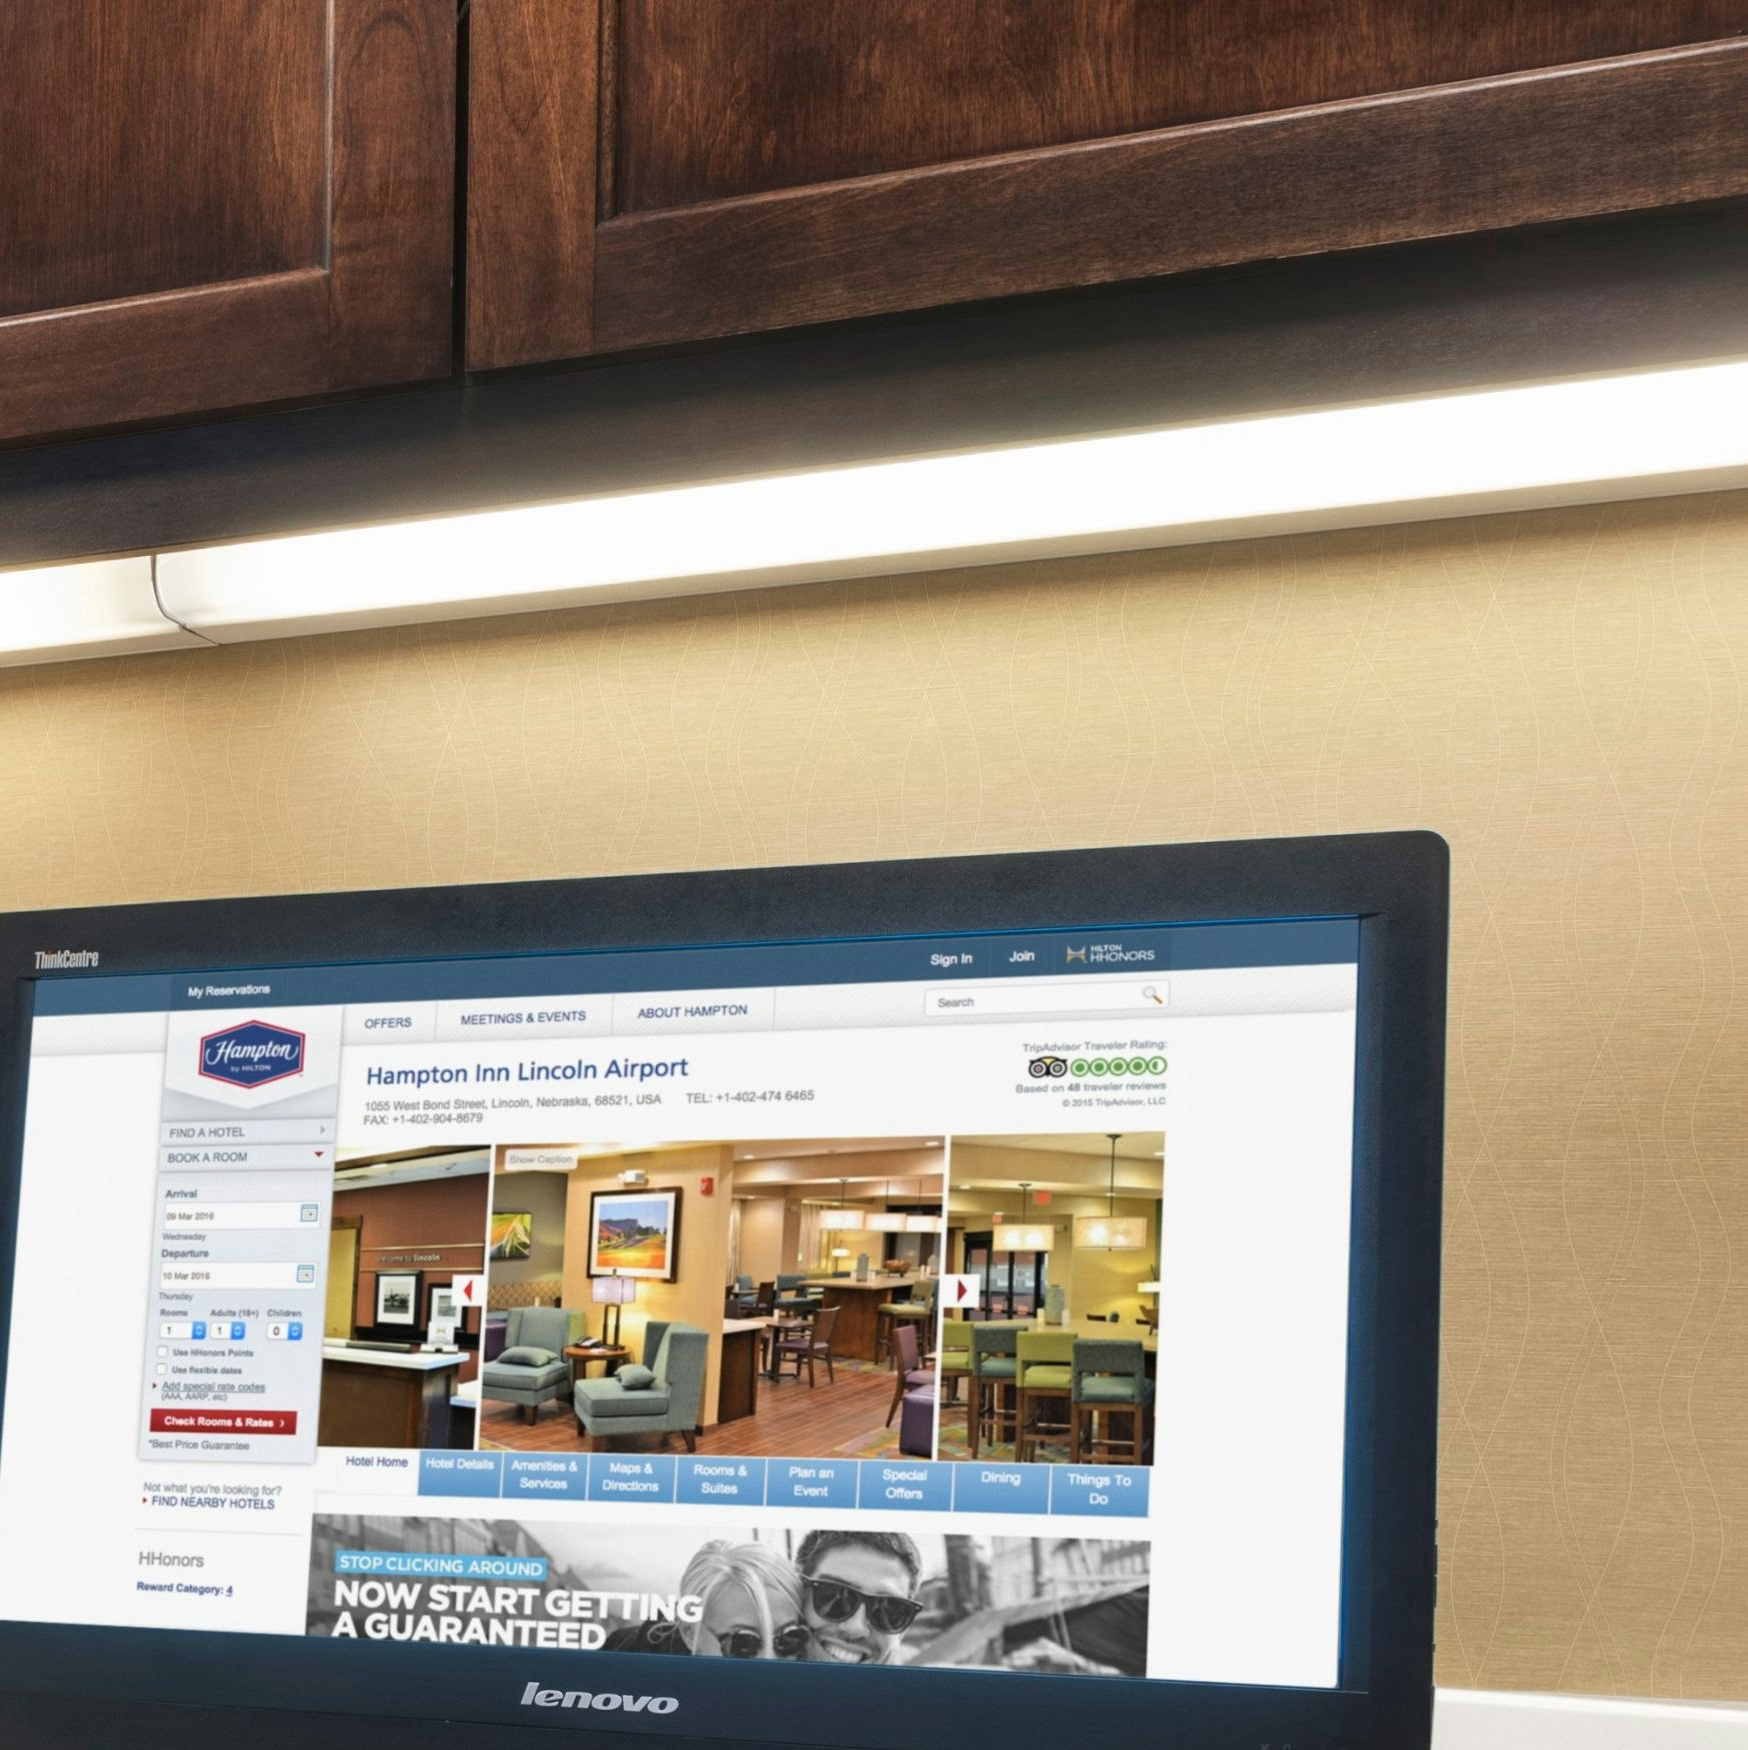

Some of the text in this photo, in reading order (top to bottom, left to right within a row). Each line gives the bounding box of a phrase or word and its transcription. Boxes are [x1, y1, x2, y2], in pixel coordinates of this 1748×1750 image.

[1090, 944, 1123, 952] HILTON
[34, 949, 99, 970] ThinkCentre
[930, 953, 973, 968] Sign In
[1009, 951, 1035, 962] Join
[1090, 951, 1155, 963] HHONORS
[188, 983, 270, 999] My Reservations
[937, 998, 974, 1008] Search
[460, 1011, 586, 1025] MEETINGS & EVENTS
[637, 1005, 748, 1019] ABOUT HAMPTON
[364, 1017, 412, 1029] OFFERS
[205, 1040, 299, 1066] Hampton
[1023, 1039, 1167, 1054] TripAdvisor Traveler Rating:
[367, 1058, 689, 1088] Hampton Inn Lincoln Airport
[1015, 1084, 1049, 1094] Based
[1067, 1083, 1081, 1092] 48
[1083, 1082, 1123, 1092] traveler
[1125, 1081, 1167, 1090] reviews
[364, 1100, 390, 1111] 1055
[393, 1099, 418, 1110] West
[420, 1098, 451, 1110] Bond
[453, 1097, 488, 1111] Street,
[492, 1097, 531, 1110] Lincoln,
[536, 1095, 591, 1109] Nebraska,
[636, 1094, 662, 1105] USA
[686, 1092, 712, 1103] TEL:
[784, 1090, 814, 1101] 6465
[364, 1114, 389, 1125] FAX:
[169, 1127, 245, 1138] FIND A HOTEL
[168, 1152, 248, 1163] BOOK A ROOM
[509, 1155, 573, 1165] Show Caption
[165, 1189, 197, 1198] Arrival
[195, 1212, 214, 1220] 2016
[163, 1233, 206, 1242] Wednesday
[161, 1249, 209, 1259] Departure
[163, 1272, 210, 1280] 10 Mar 2016
[159, 1292, 193, 1301] Thursday
[160, 1309, 188, 1317] Rooms
[210, 1309, 236, 1317] Adults
[267, 1309, 302, 1317] Children
[273, 1327, 280, 1335] 0
[162, 1382, 265, 1394] Add special rate codes
[164, 1416, 274, 1428] Check Rooms & Rates
[175, 1440, 198, 1449] Price
[201, 1441, 249, 1451] Guarantee
[346, 1455, 408, 1468] Hotel Home
[426, 1457, 495, 1471] Hotel Details
[511, 1459, 578, 1472] Amenities &
[610, 1462, 653, 1476] Maps &
[694, 1465, 747, 1477] Rooms &
[789, 1467, 834, 1479] Plan an
[883, 1468, 927, 1483] Special
[520, 1478, 567, 1490] Services
[981, 1472, 1021, 1486] Dining
[1068, 1473, 1131, 1487] Things To
[144, 1483, 281, 1497] Not what you're looking for?
[602, 1480, 659, 1493] Directions
[701, 1482, 738, 1495] Suites
[793, 1485, 828, 1497] Event
[886, 1486, 923, 1500] Offers
[152, 1496, 275, 1509] FIND NEARBY HOTELS
[1089, 1493, 1109, 1505] Do
[139, 1551, 204, 1568] HHonors
[340, 1556, 543, 1577] STOP CLICKING AROUND
[137, 1581, 233, 1597] Reward Category: 4
[334, 1580, 704, 1623] NOW START GETTING
[332, 1612, 607, 1651] A GUARANTEED
[520, 1682, 679, 1714] lenovo
